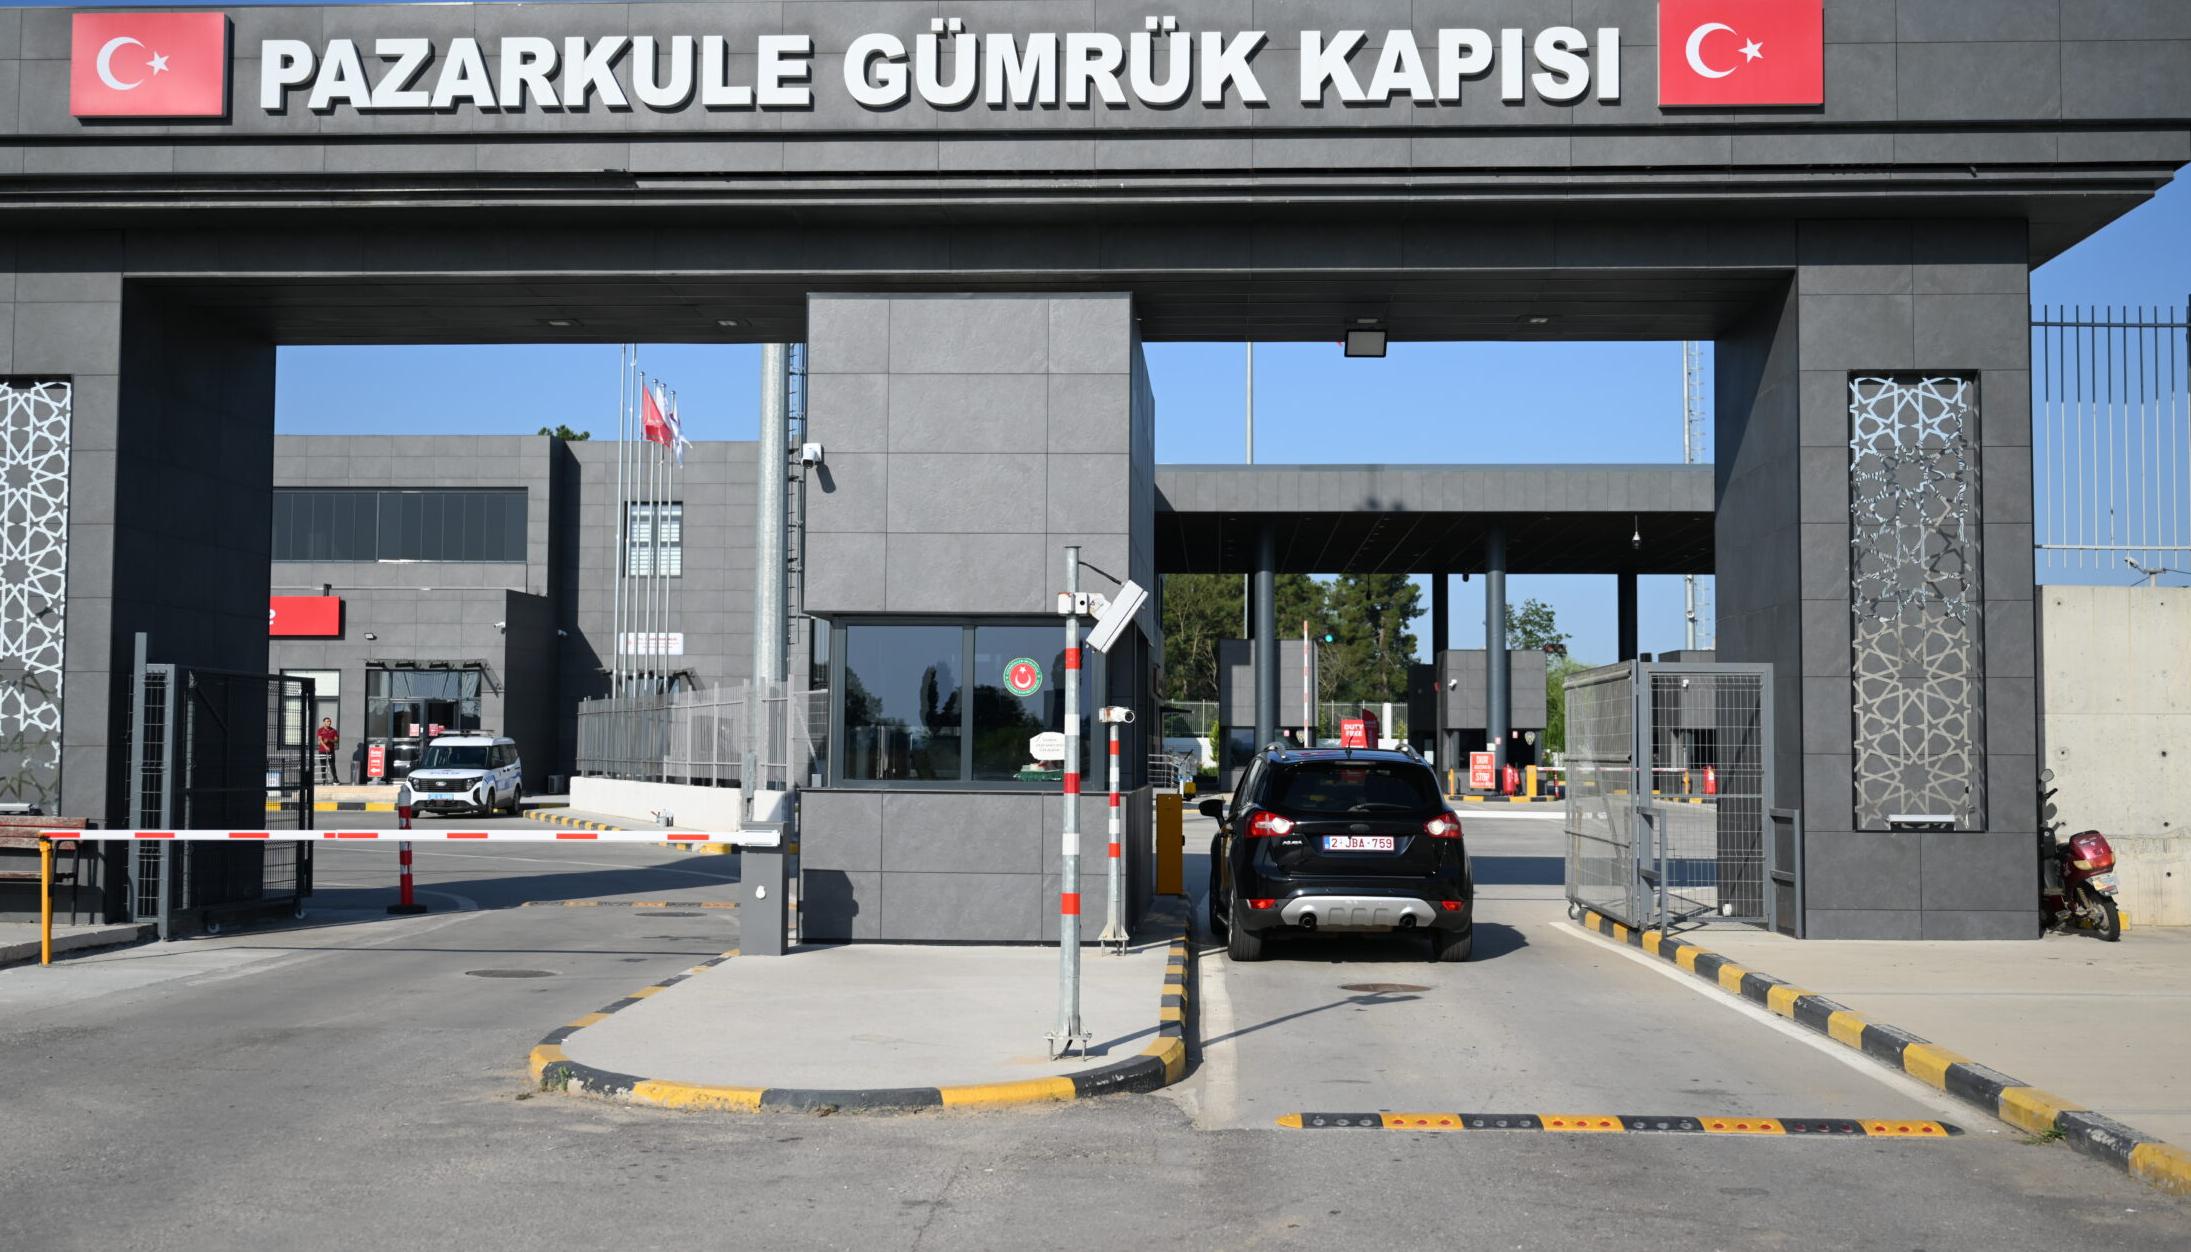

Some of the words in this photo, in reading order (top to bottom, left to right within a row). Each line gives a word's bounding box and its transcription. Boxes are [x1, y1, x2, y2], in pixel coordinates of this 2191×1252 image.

[260, 34, 812, 112] PAZARKULE
[843, 17, 1268, 107] GÜMRÜK
[1300, 26, 1621, 103] KAPISI
